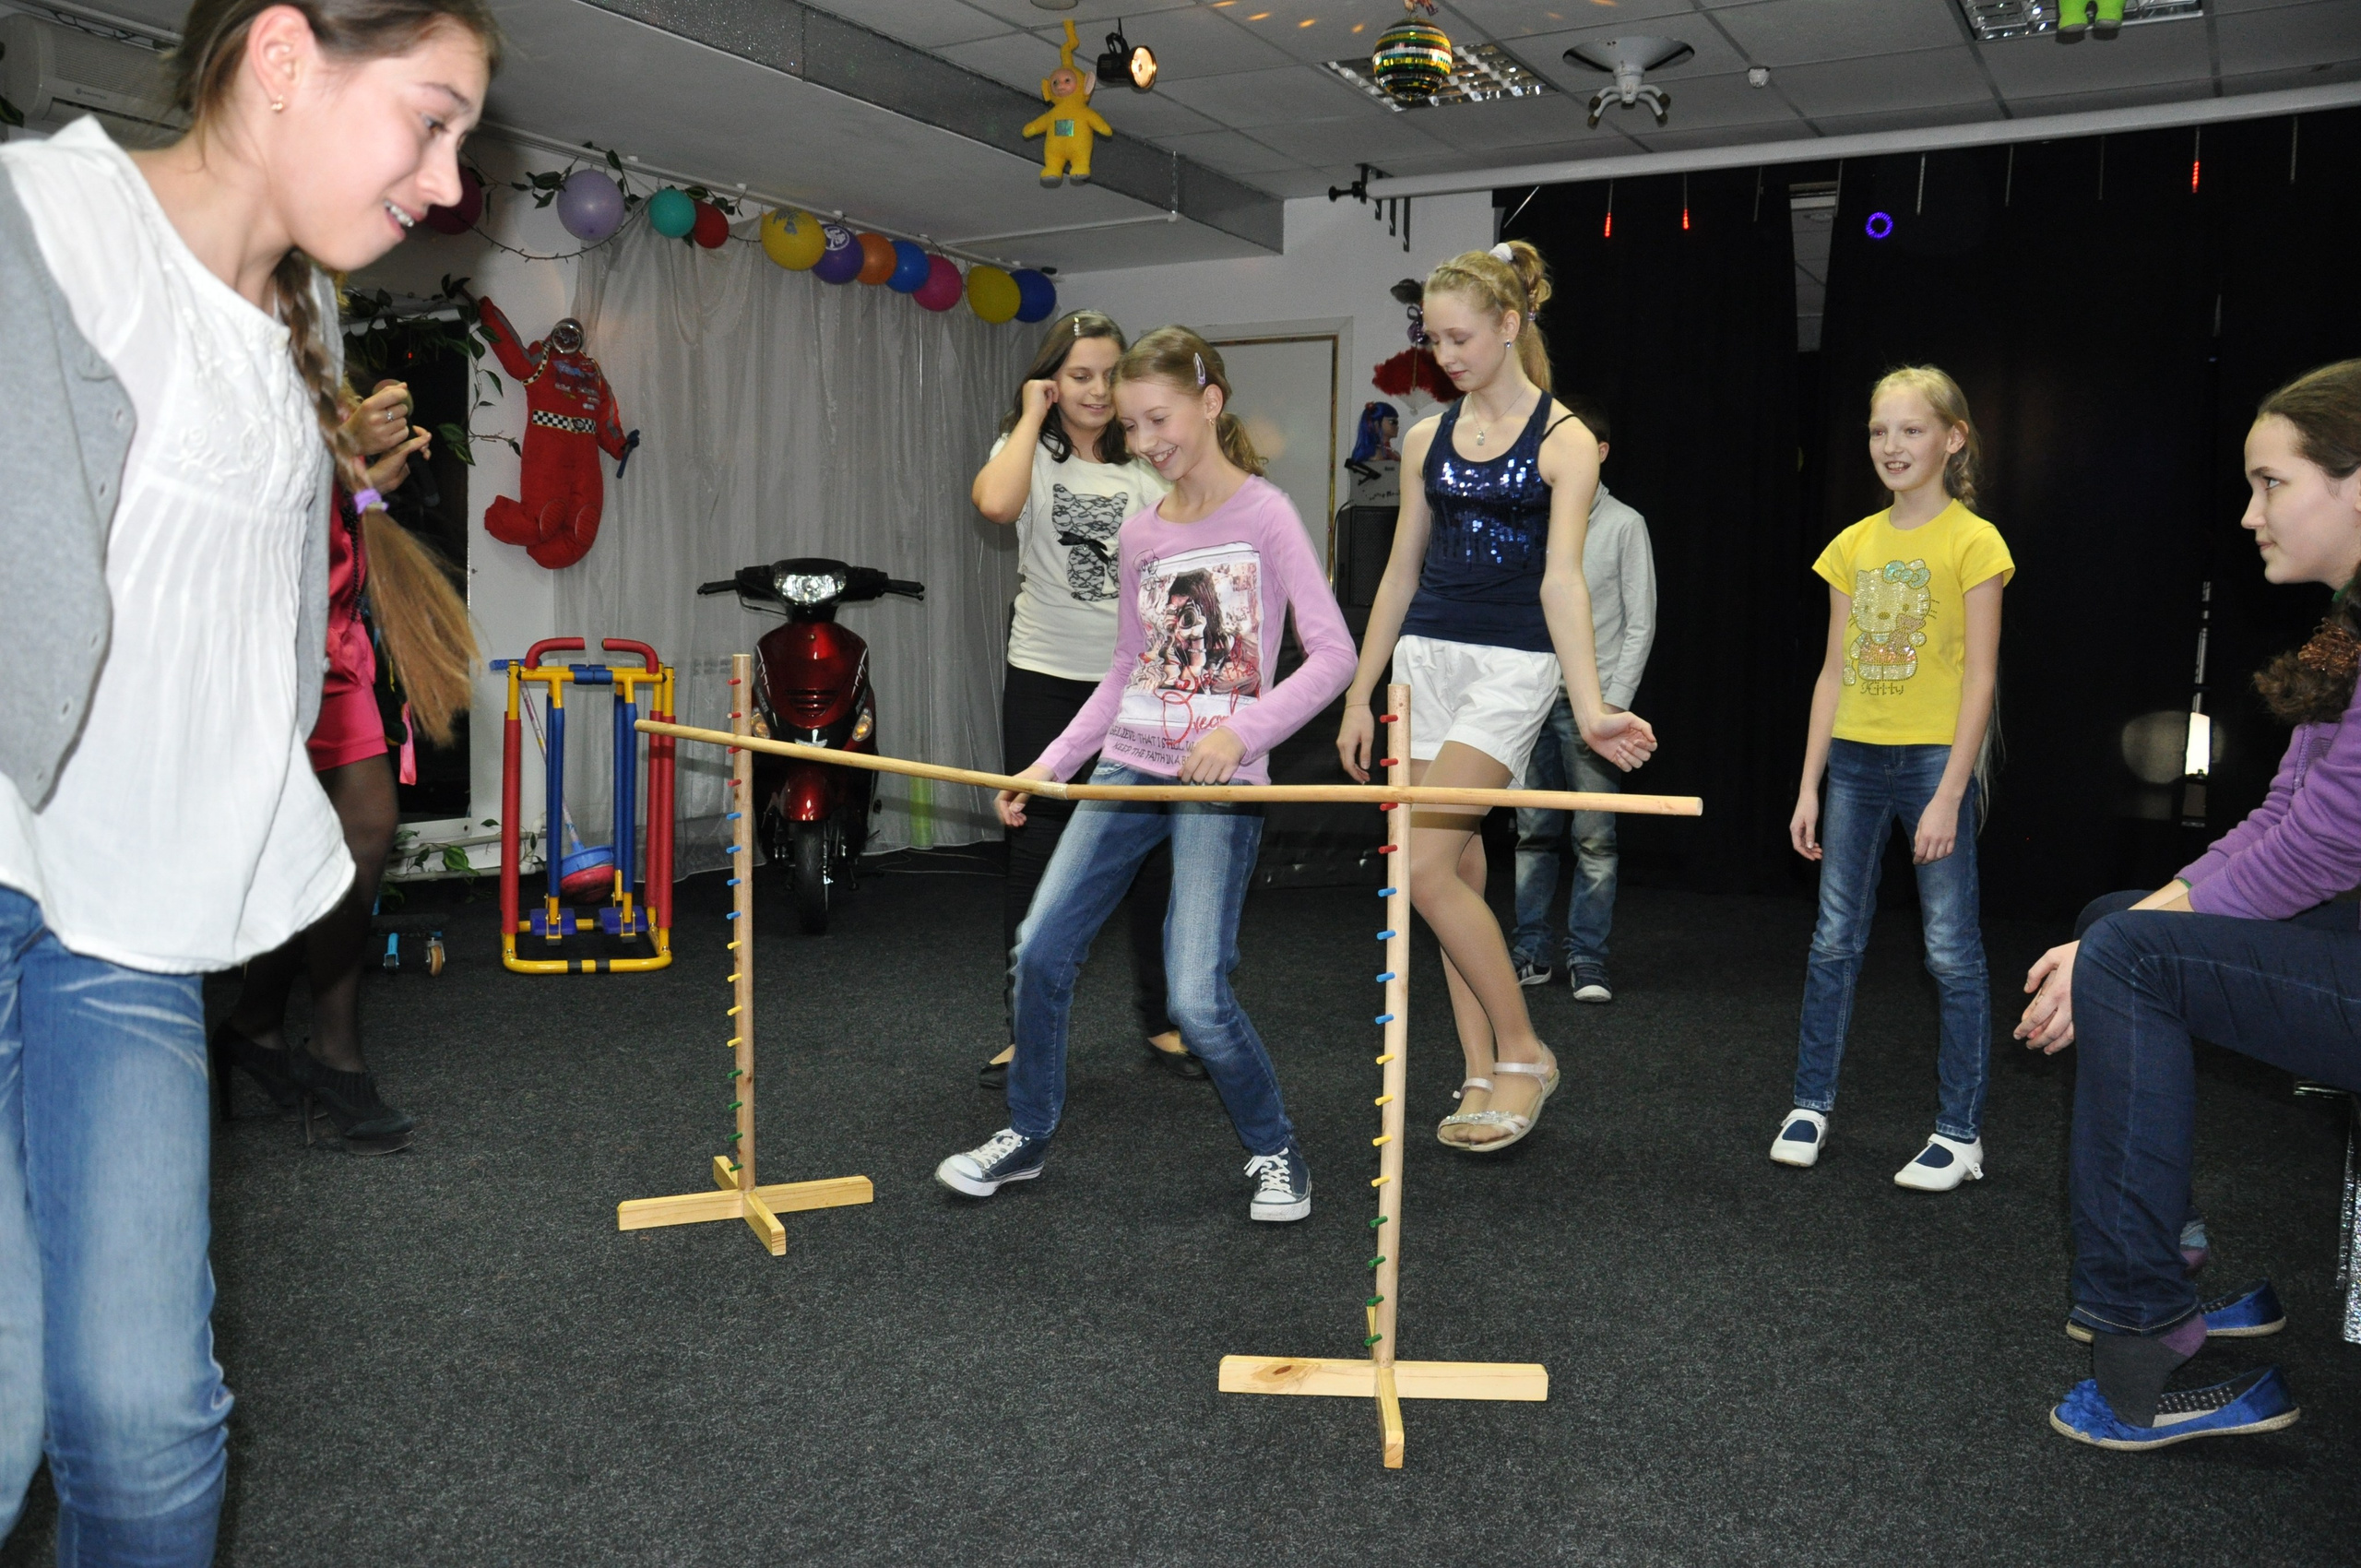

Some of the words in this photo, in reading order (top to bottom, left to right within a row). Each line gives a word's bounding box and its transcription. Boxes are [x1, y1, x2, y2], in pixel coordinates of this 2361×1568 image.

[1859, 681, 1904, 695] Kitty
[1137, 732, 1157, 748] THAT
[1113, 742, 1133, 753] KEEP
[1132, 747, 1146, 758] THE
[1145, 750, 1166, 764] FAITH
